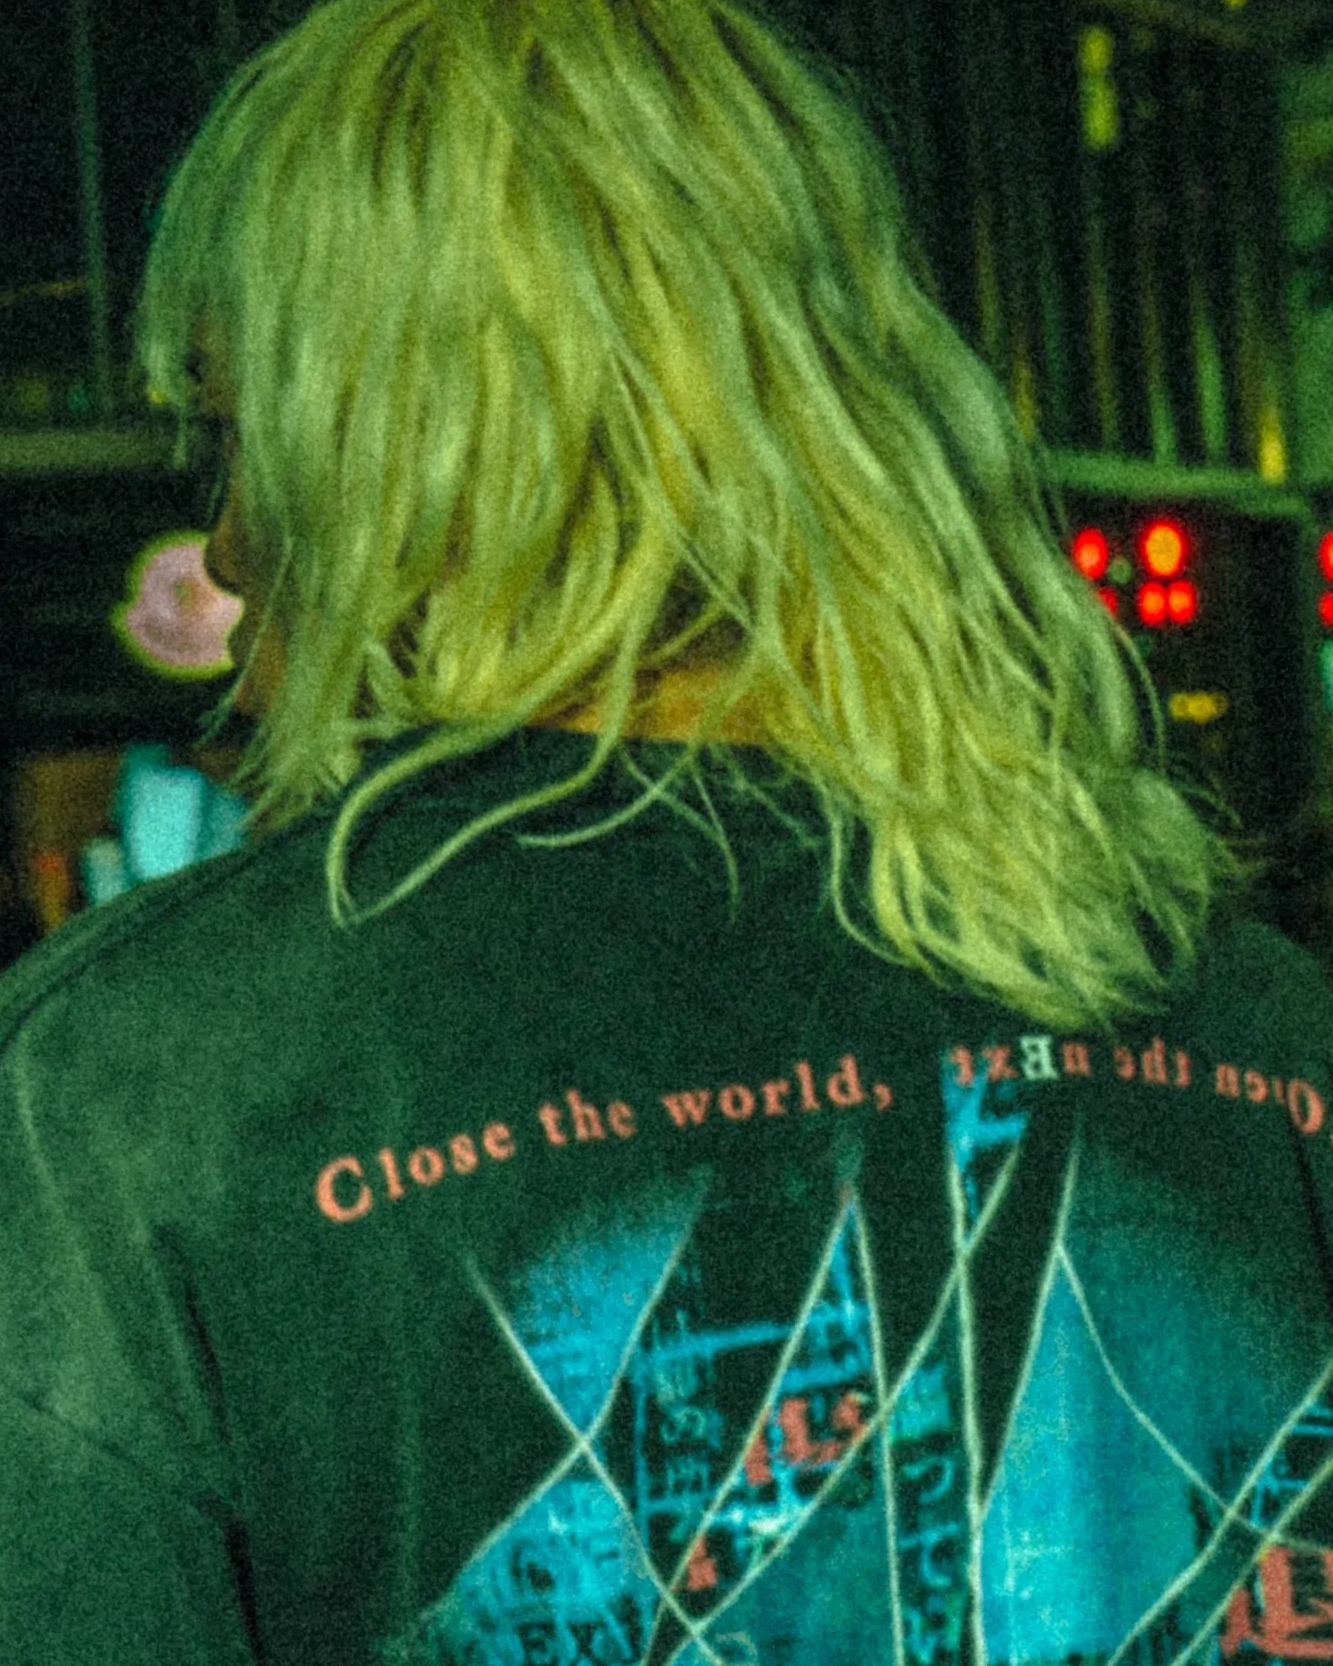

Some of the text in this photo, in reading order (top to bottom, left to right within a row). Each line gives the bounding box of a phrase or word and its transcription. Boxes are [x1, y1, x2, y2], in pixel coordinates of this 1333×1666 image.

[314, 1054, 894, 1223] Close the world,
